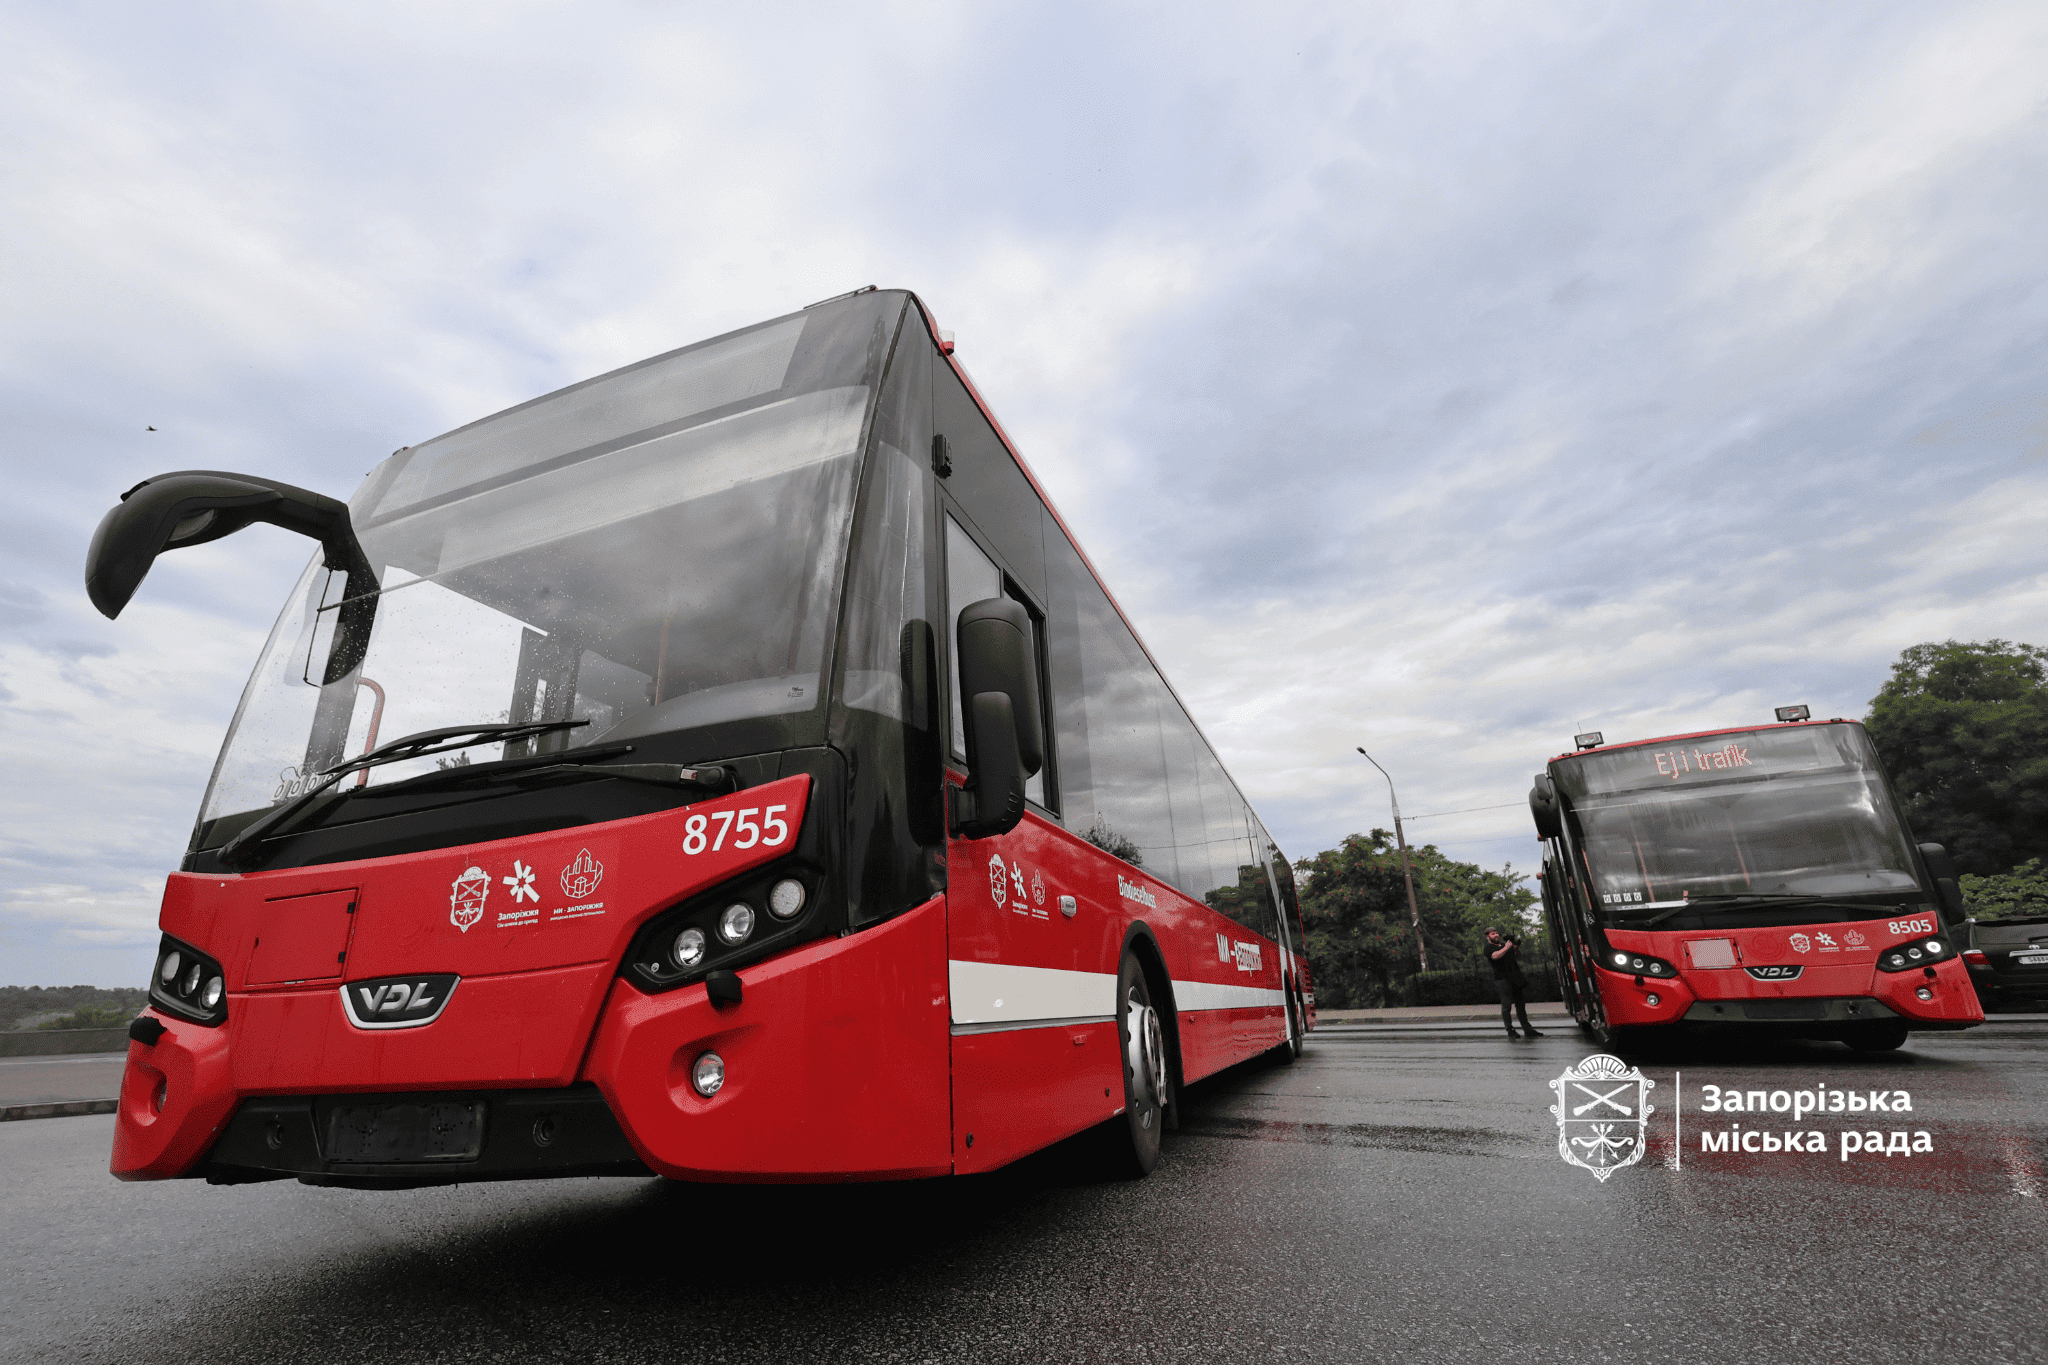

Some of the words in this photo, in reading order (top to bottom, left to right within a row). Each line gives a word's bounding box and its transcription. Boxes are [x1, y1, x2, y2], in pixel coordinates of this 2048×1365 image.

[1654, 752, 1680, 779] Ej
[1680, 750, 1690, 772] i
[1693, 744, 1753, 771] trafik
[682, 804, 788, 855] 8755
[497, 909, 539, 921] Запоріжжя
[1888, 919, 1933, 935] 8505
[1753, 966, 1794, 976] VDL
[359, 982, 435, 1013] VDL
